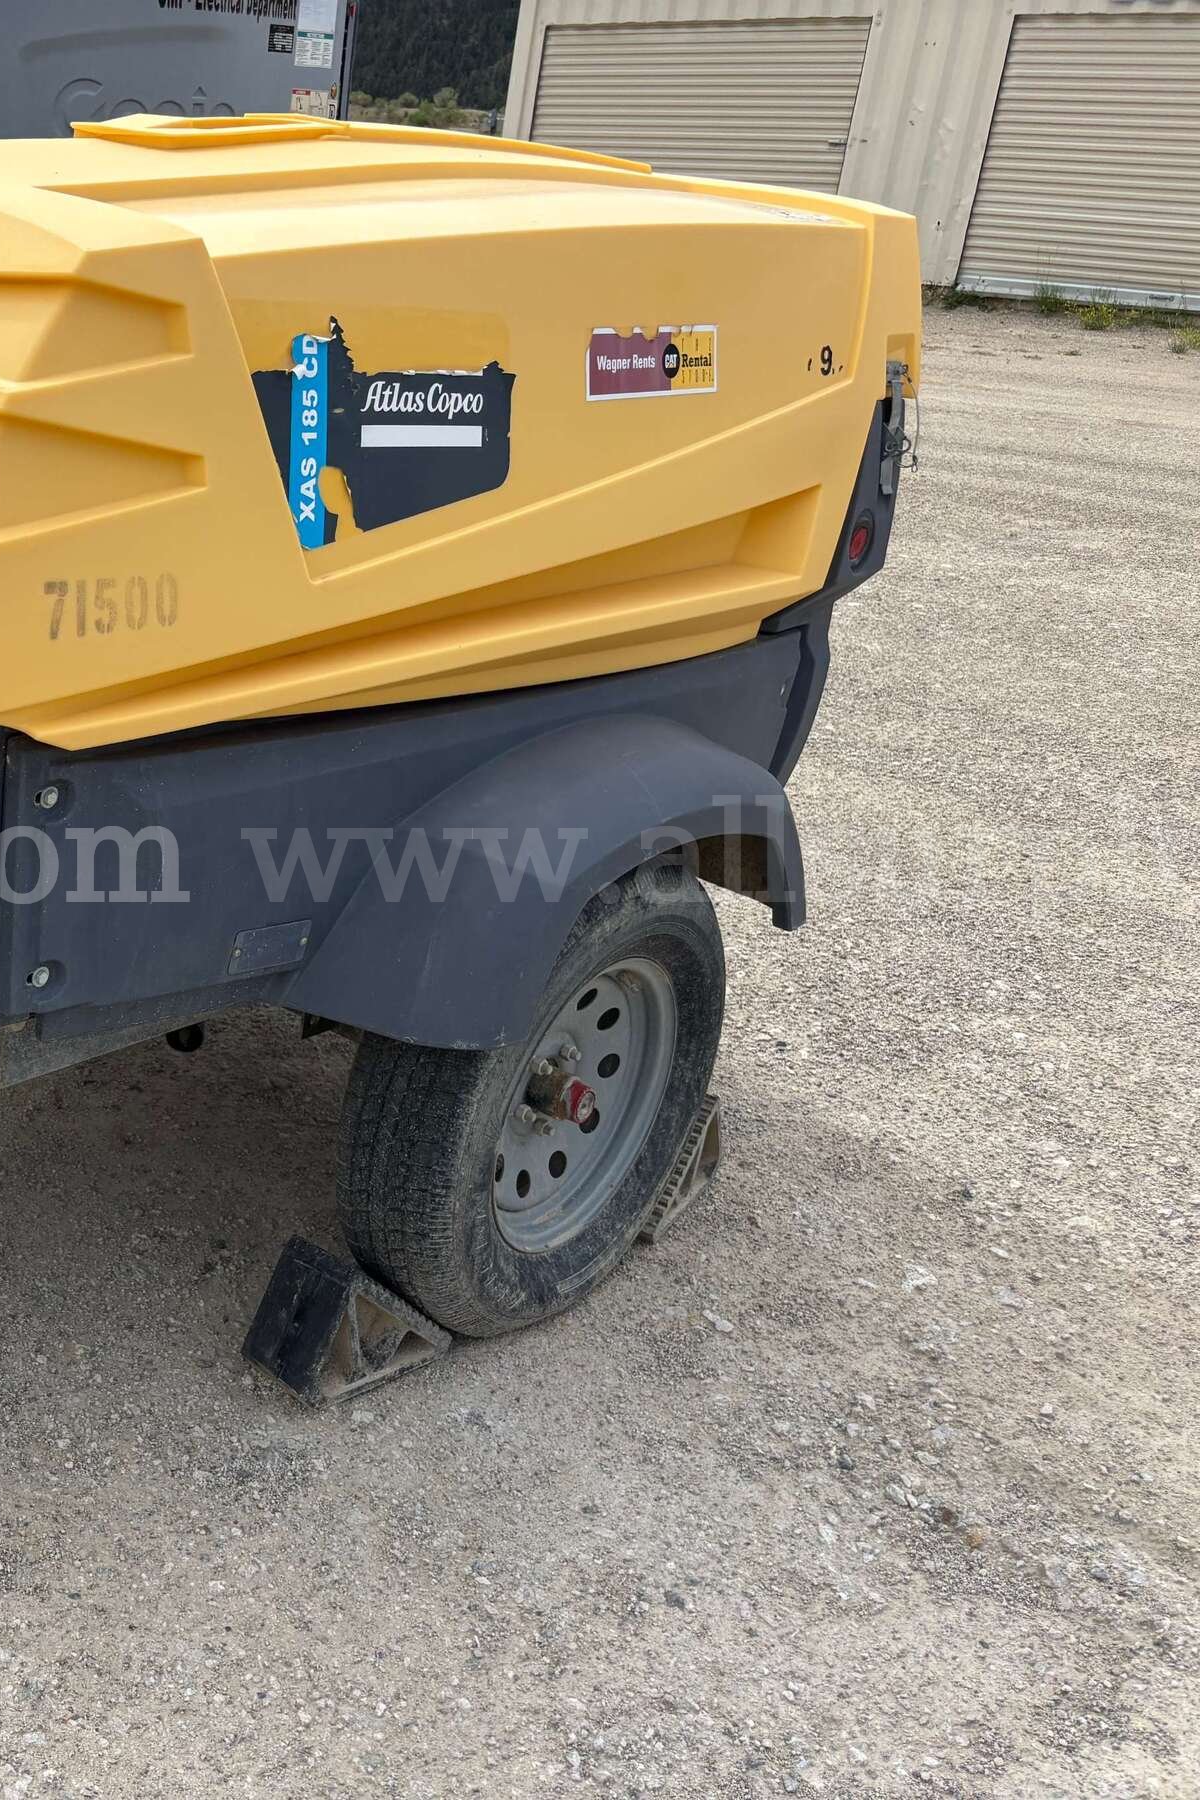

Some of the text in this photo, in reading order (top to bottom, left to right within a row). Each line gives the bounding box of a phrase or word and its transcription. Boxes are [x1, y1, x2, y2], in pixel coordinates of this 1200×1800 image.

[596, 353, 656, 374] Wagner Rents
[664, 352, 712, 369] CAT Rental
[360, 380, 484, 420] Atlas Copco
[299, 335, 318, 522] XAS 185 CD
[43, 572, 178, 640] 71500
